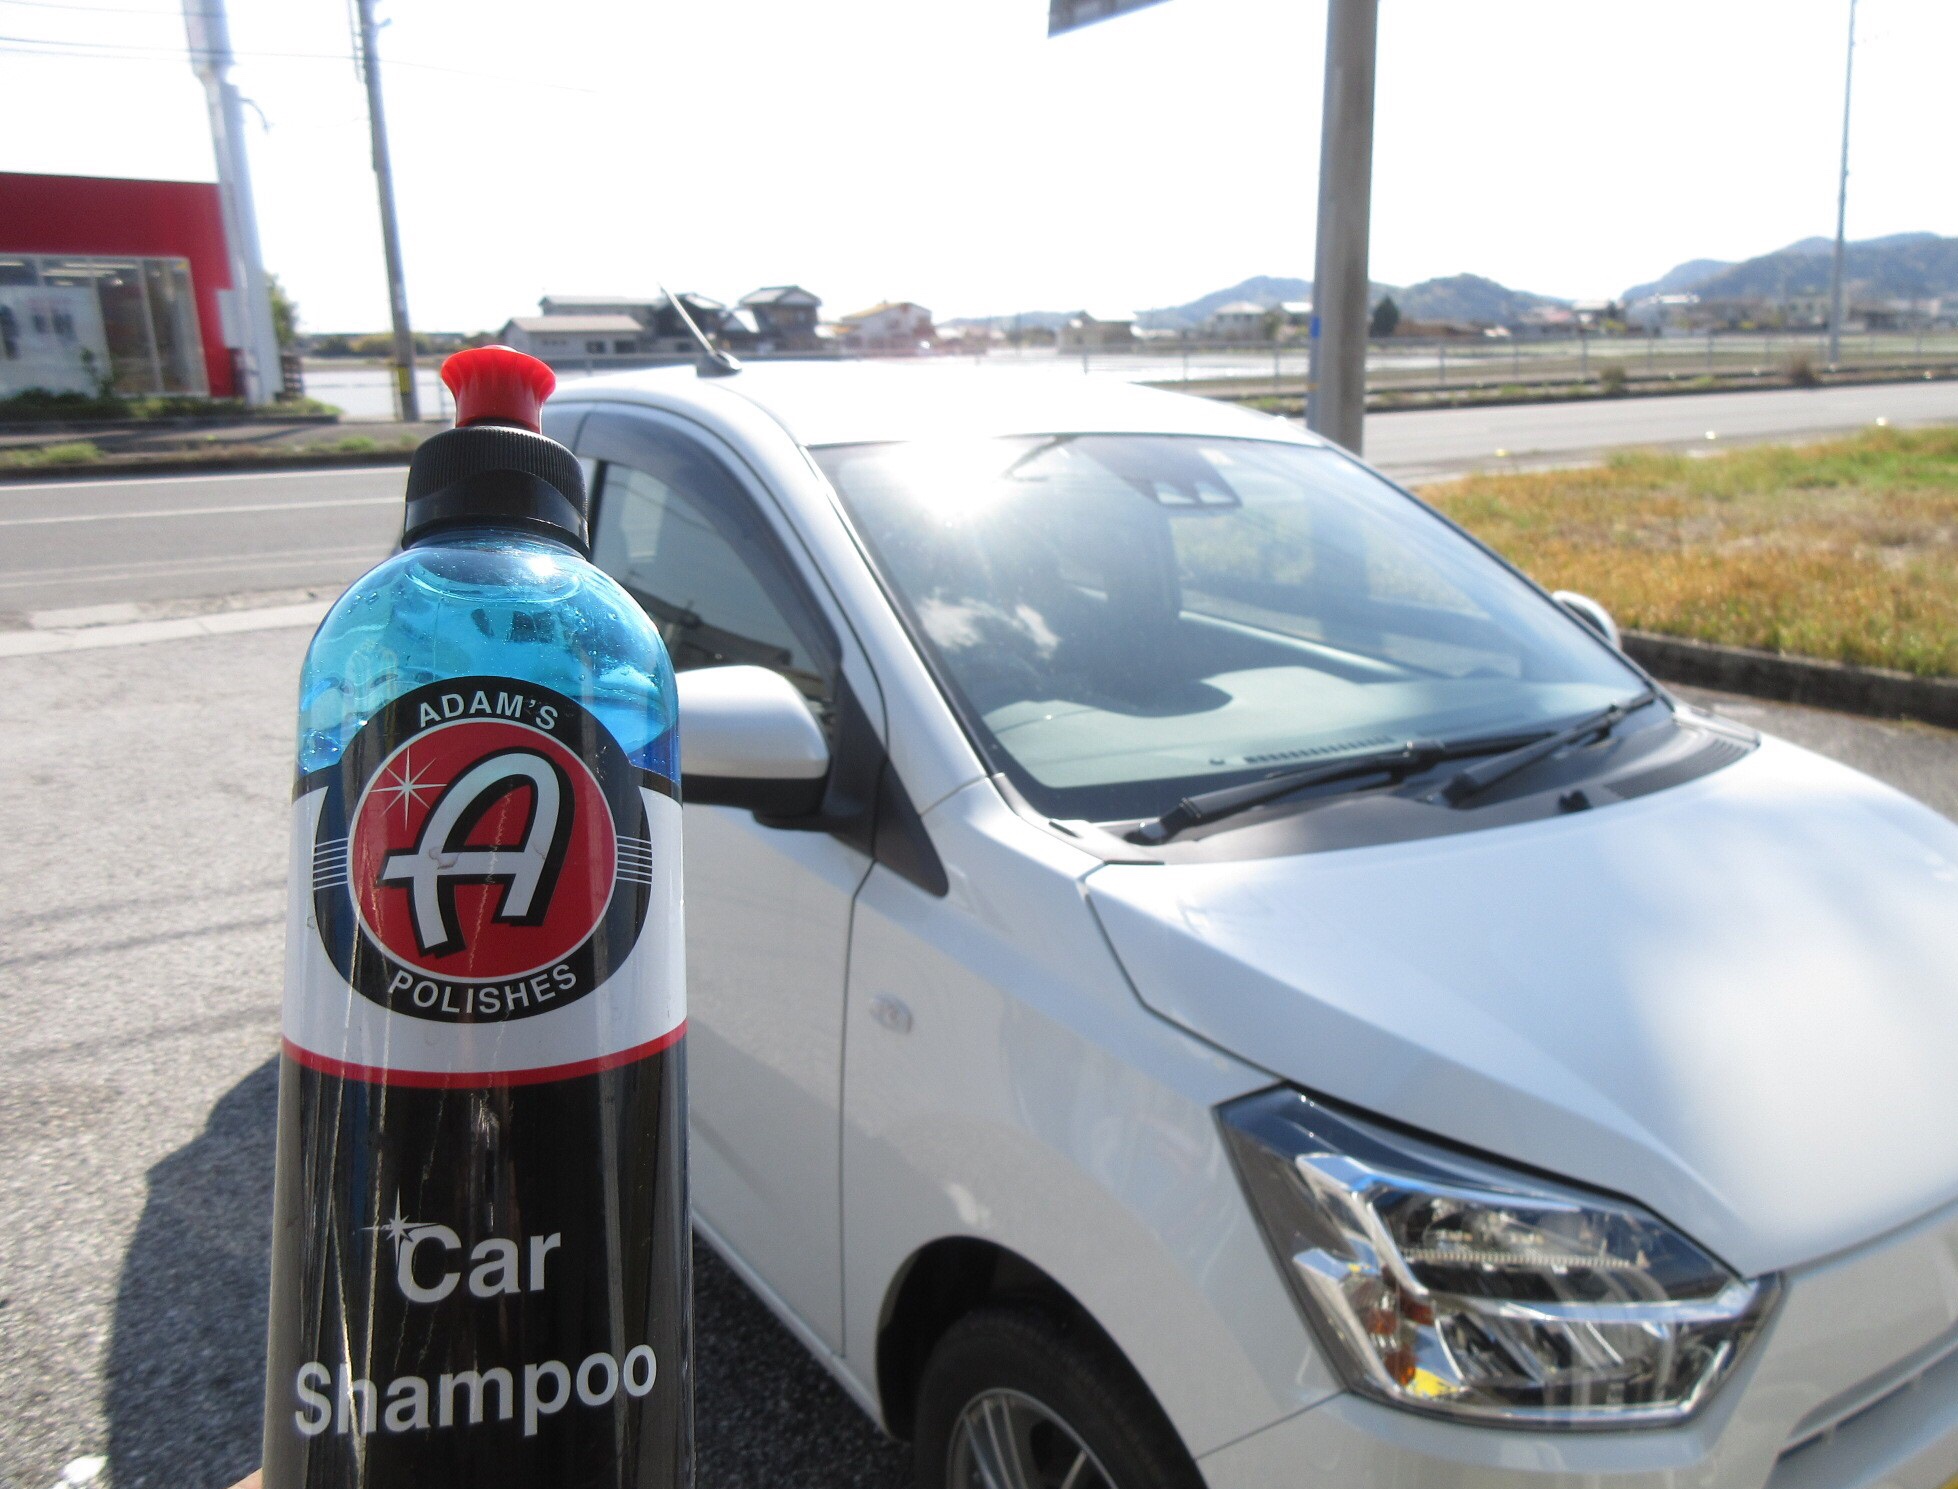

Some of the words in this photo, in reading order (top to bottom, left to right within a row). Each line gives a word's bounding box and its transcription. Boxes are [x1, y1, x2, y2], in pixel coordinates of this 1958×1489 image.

[418, 690, 559, 730] ADAM'S
[388, 962, 578, 1014] POLISHES
[397, 1222, 561, 1303] Car
[294, 1343, 658, 1438] Shampoo
